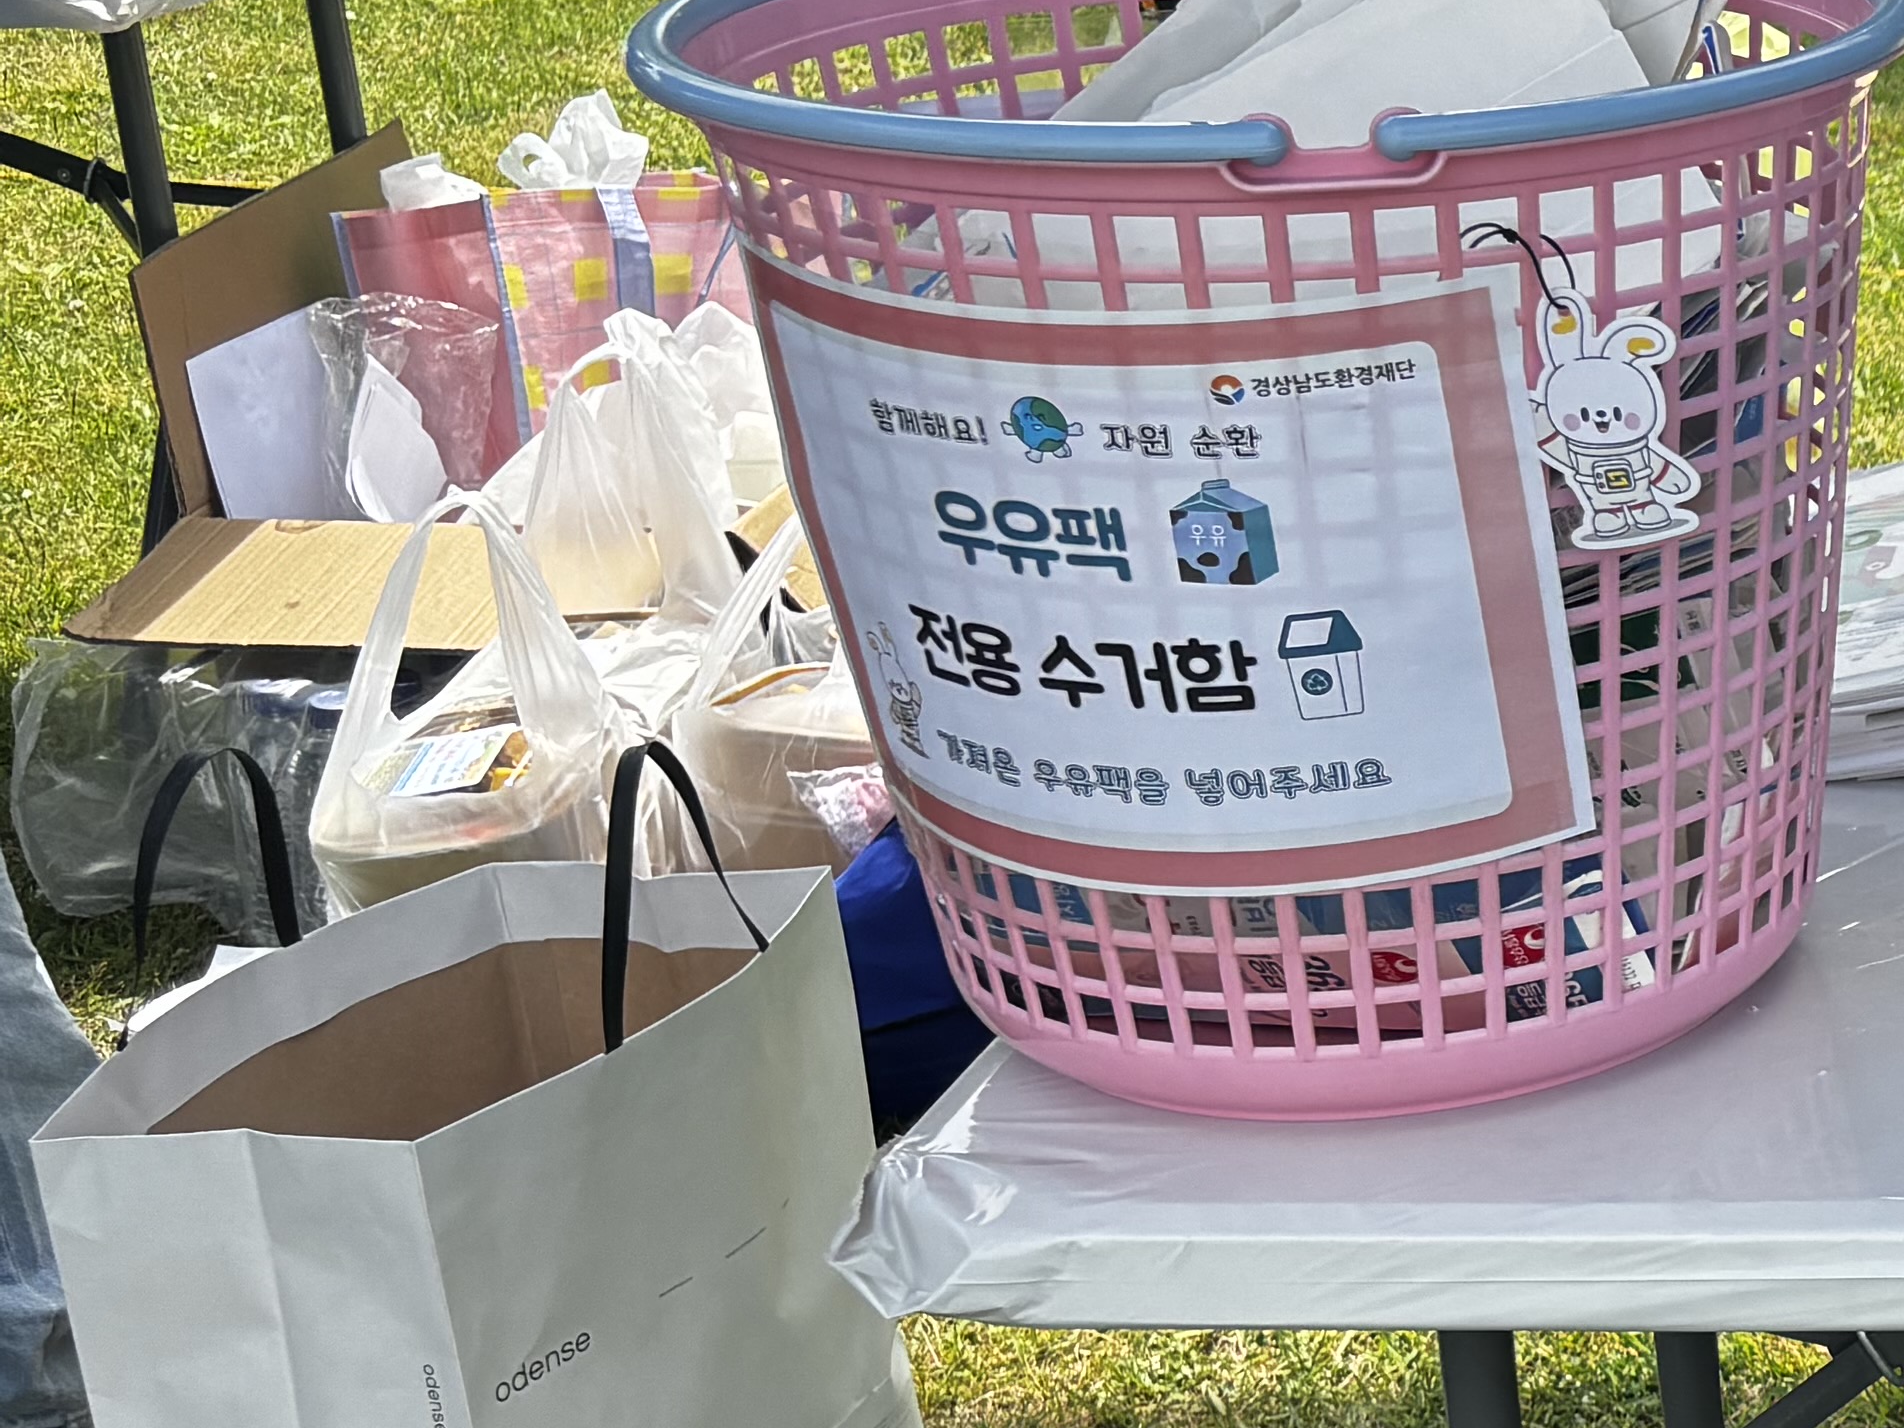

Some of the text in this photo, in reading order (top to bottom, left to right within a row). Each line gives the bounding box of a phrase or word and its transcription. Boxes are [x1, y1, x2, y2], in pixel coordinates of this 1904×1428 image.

[1250, 358, 1417, 399] 경상남도환경재단
[868, 397, 1263, 461] 함께해요! 자원 순환
[935, 490, 1132, 583] 우유팩
[1189, 523, 1227, 548] 우유
[908, 602, 1259, 714] 전용 수거함
[1033, 758, 1171, 807] 우유팩을
[1184, 757, 1394, 808] 넣어주세요
[495, 1332, 592, 1403] odense
